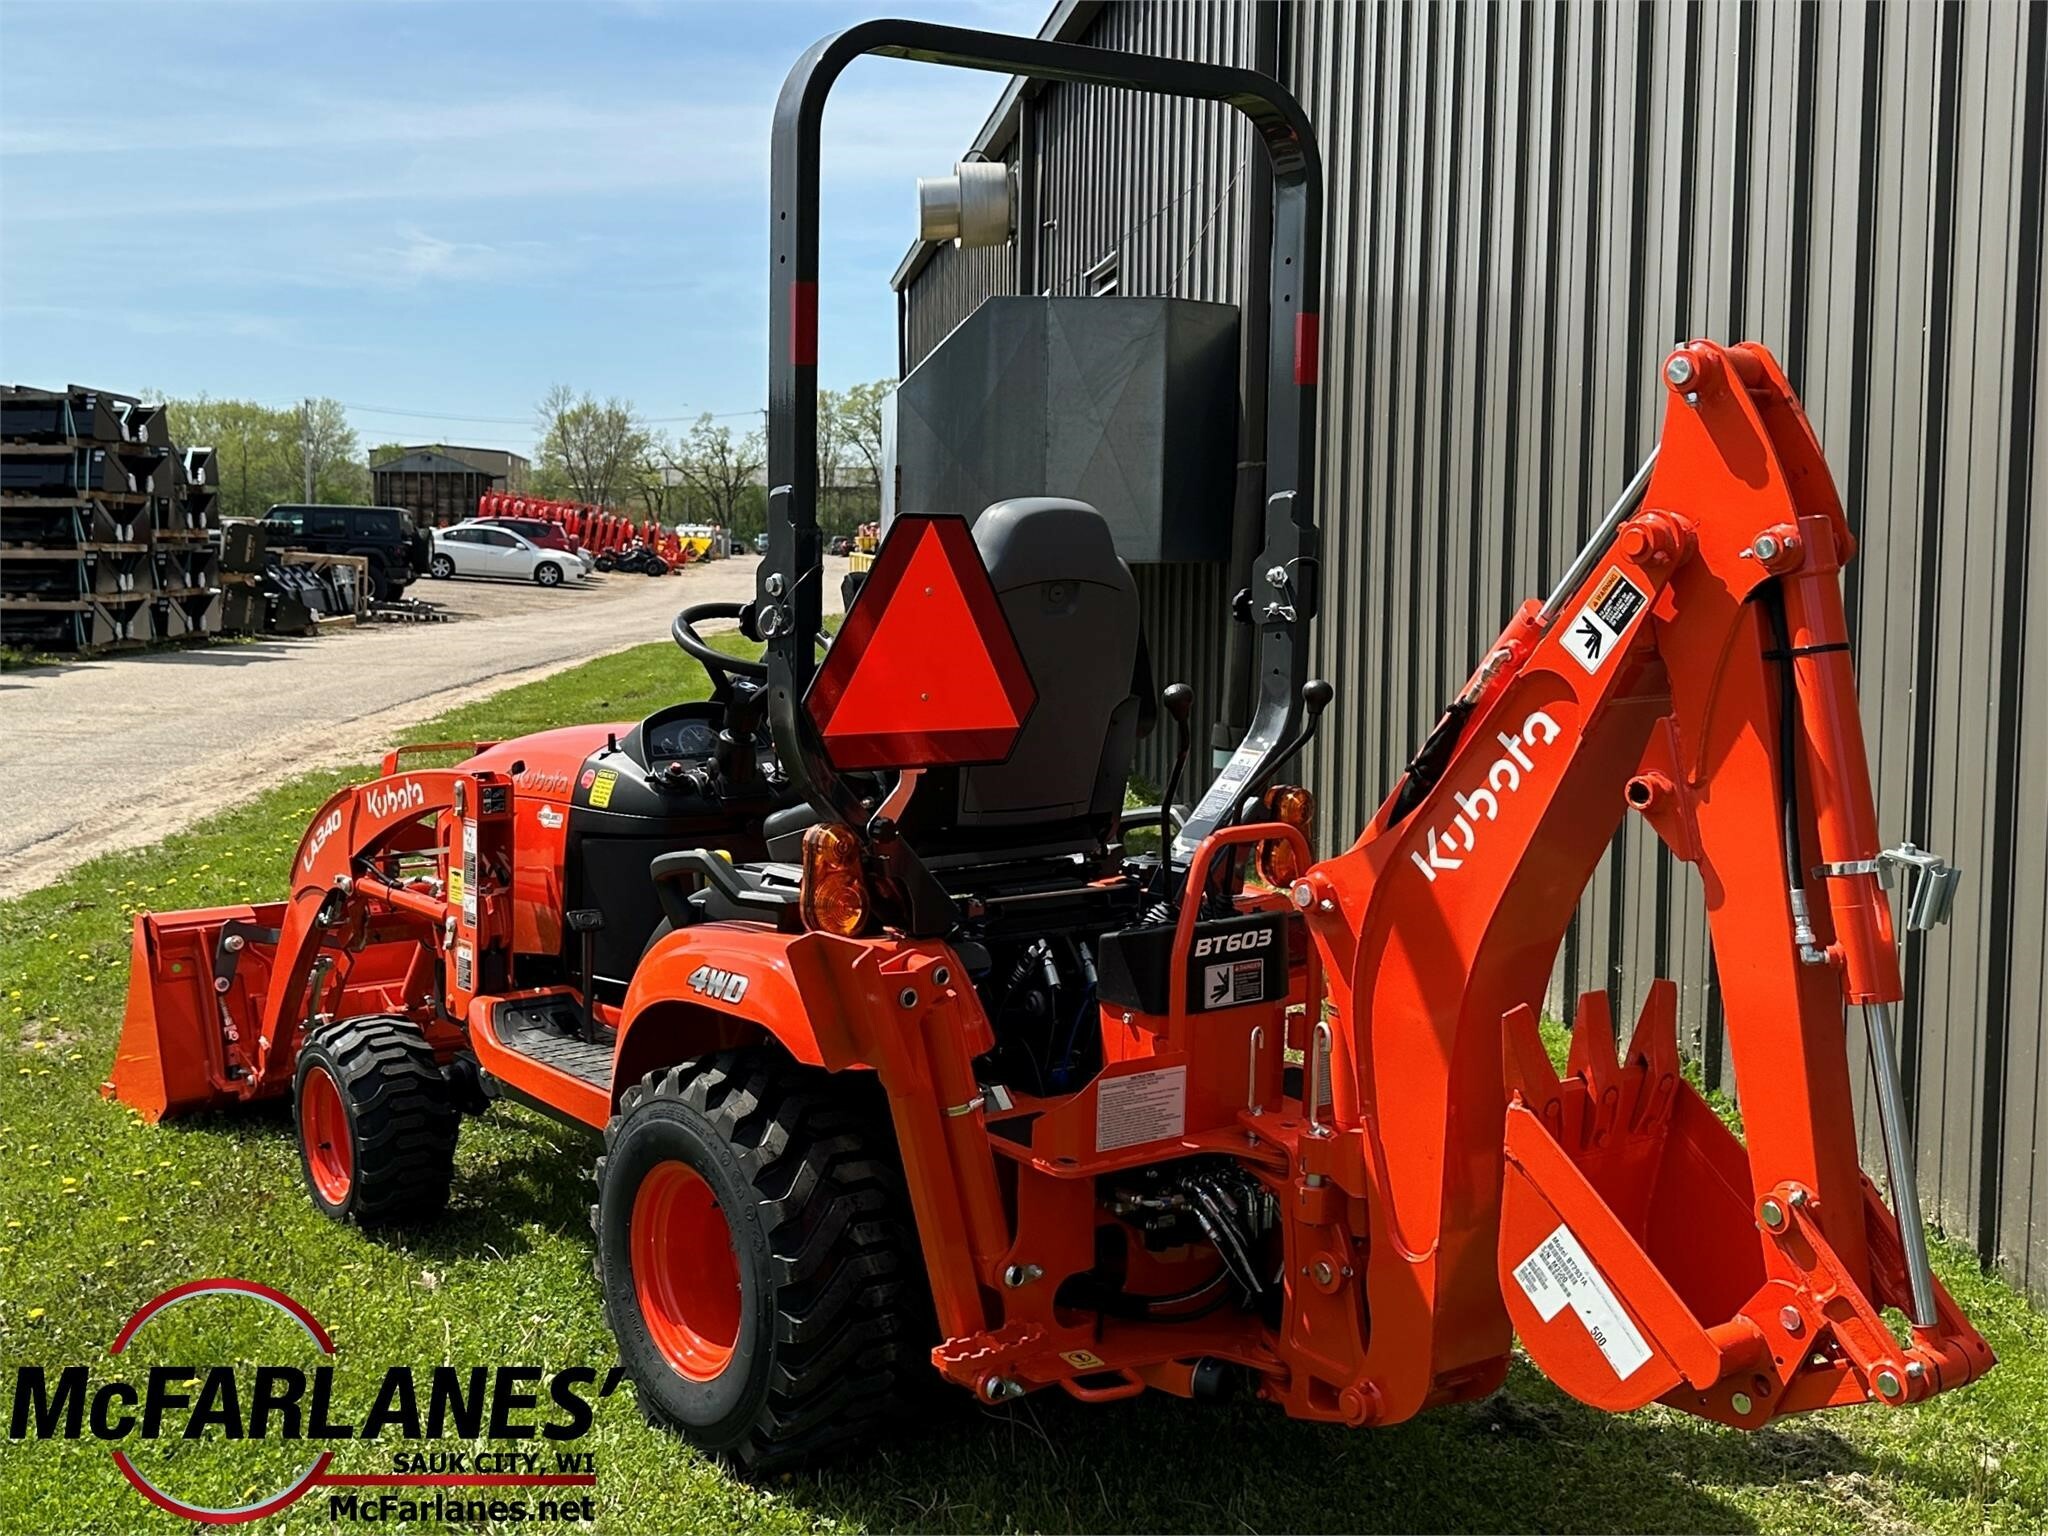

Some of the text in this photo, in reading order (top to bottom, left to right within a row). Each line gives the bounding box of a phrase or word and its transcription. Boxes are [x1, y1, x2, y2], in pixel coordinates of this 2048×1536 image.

[513, 768, 569, 793] Kubota
[1411, 711, 1562, 882] Kubota
[366, 777, 424, 819] Kubota
[303, 809, 342, 873] LA340
[1194, 928, 1273, 957] BT603
[687, 965, 749, 1004] 4WD
[1552, 1236, 1568, 1258] Model
[1590, 1326, 1607, 1347] 500
